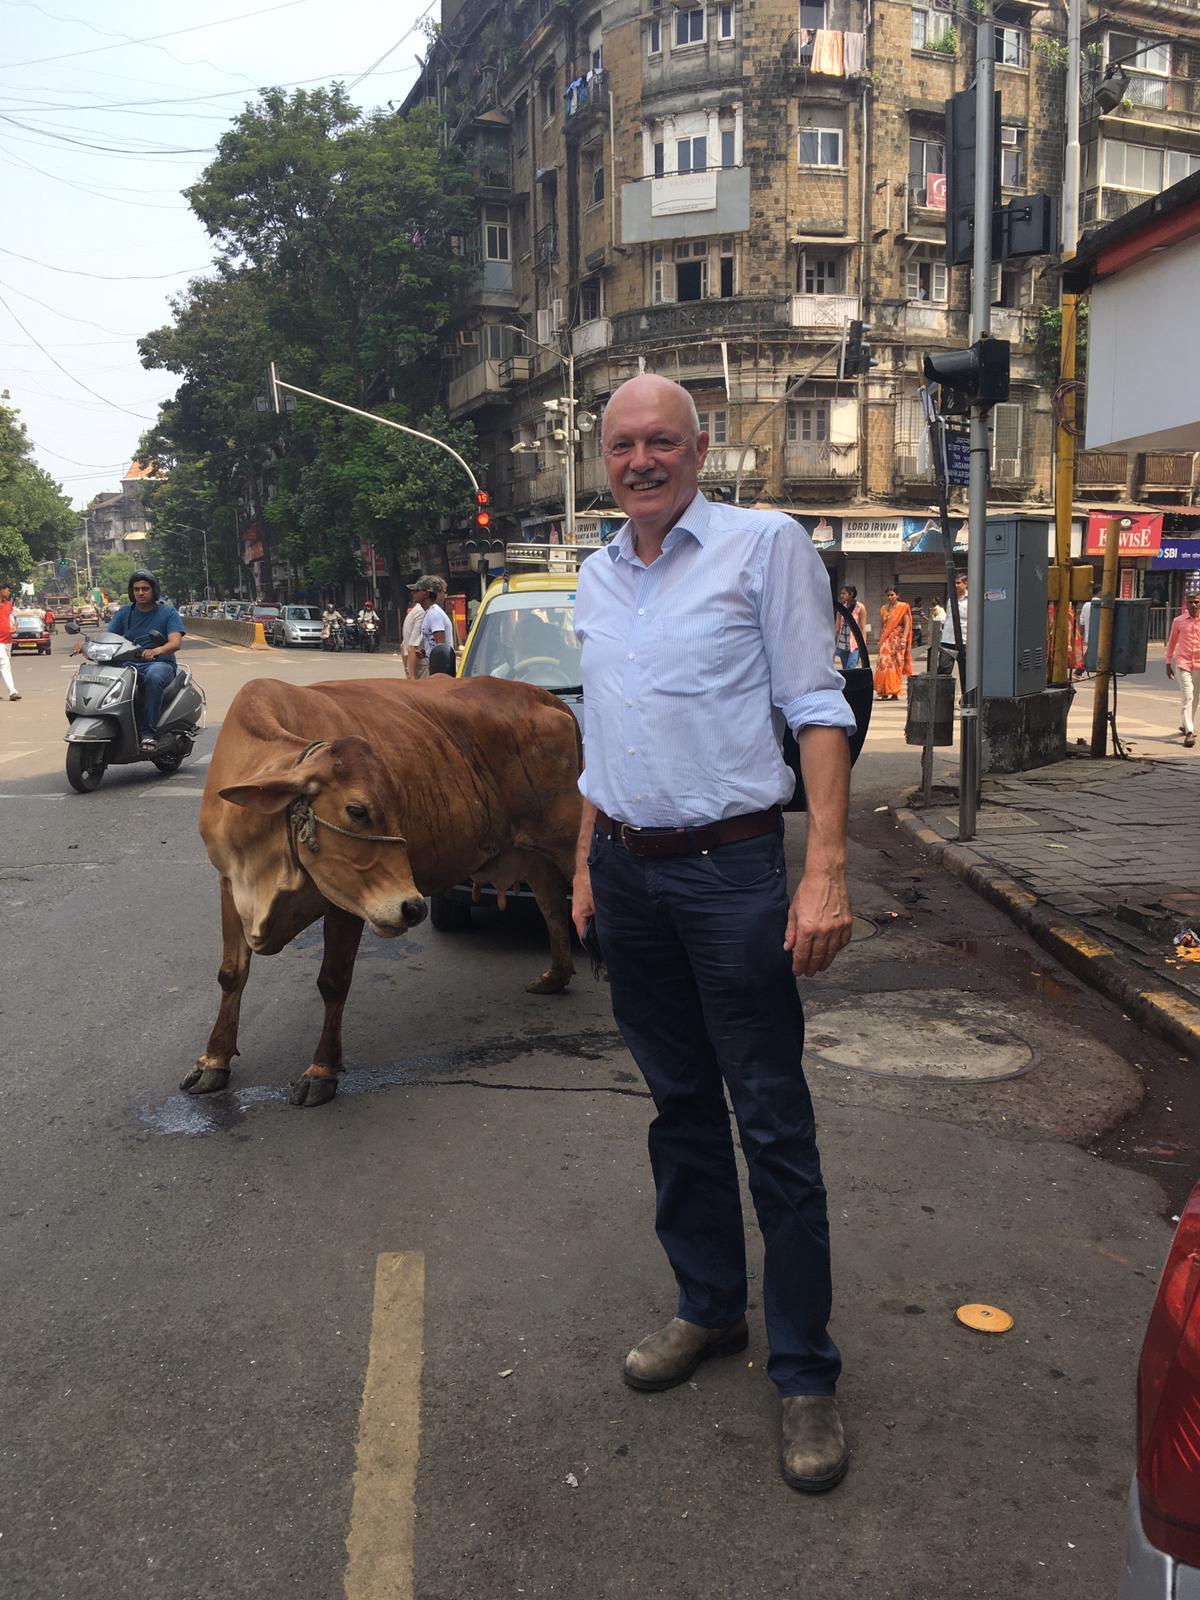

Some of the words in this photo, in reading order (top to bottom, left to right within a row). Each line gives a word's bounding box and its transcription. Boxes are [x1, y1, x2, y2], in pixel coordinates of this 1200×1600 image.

[478, 495, 488, 503] 15
[577, 523, 597, 532] IRWIN
[847, 523, 869, 532] LORD
[870, 522, 898, 532] IRWIN
[1164, 548, 1178, 559] SBI
